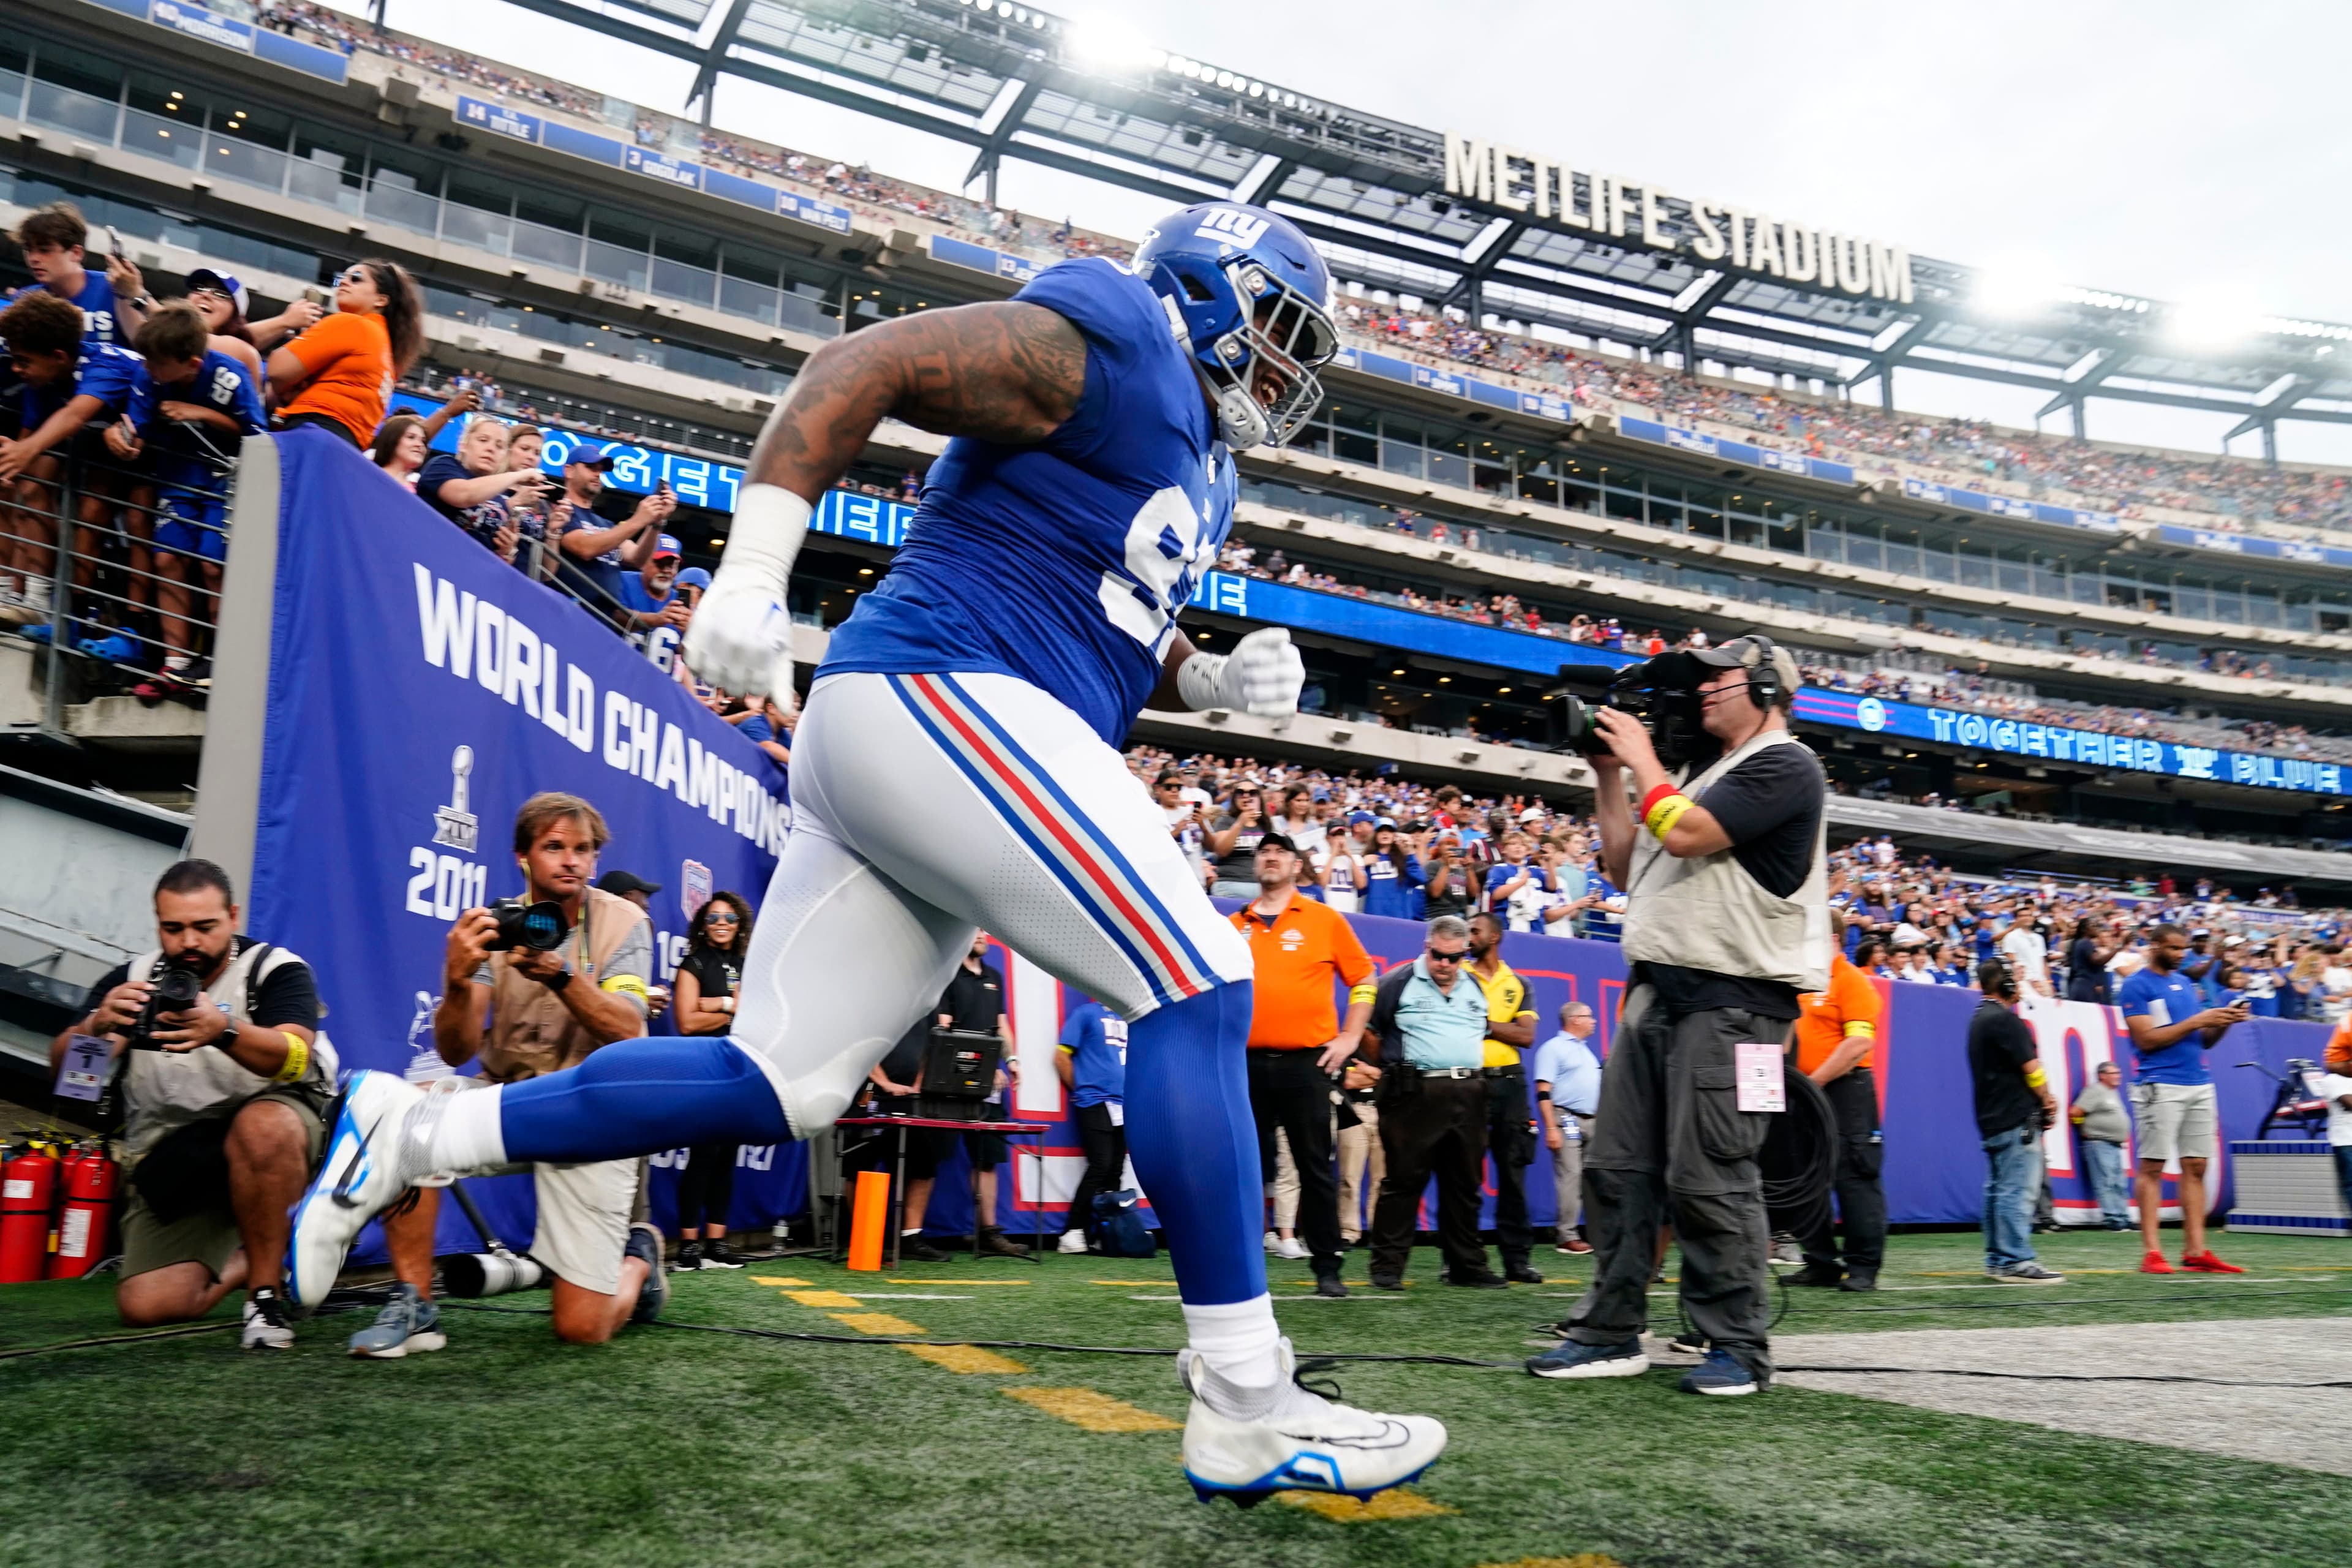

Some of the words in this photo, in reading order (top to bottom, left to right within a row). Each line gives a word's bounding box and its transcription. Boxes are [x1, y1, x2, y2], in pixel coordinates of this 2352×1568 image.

[628, 151, 642, 166] 3
[1444, 127, 1676, 250] METLIFE
[1691, 198, 1913, 304] STADIUM
[413, 562, 594, 753] WORLD
[603, 690, 793, 858] CHAMPIONS
[1927, 707, 2163, 773] TOGETHER
[2231, 753, 2342, 794] BLUE
[405, 846, 488, 921] 2011
